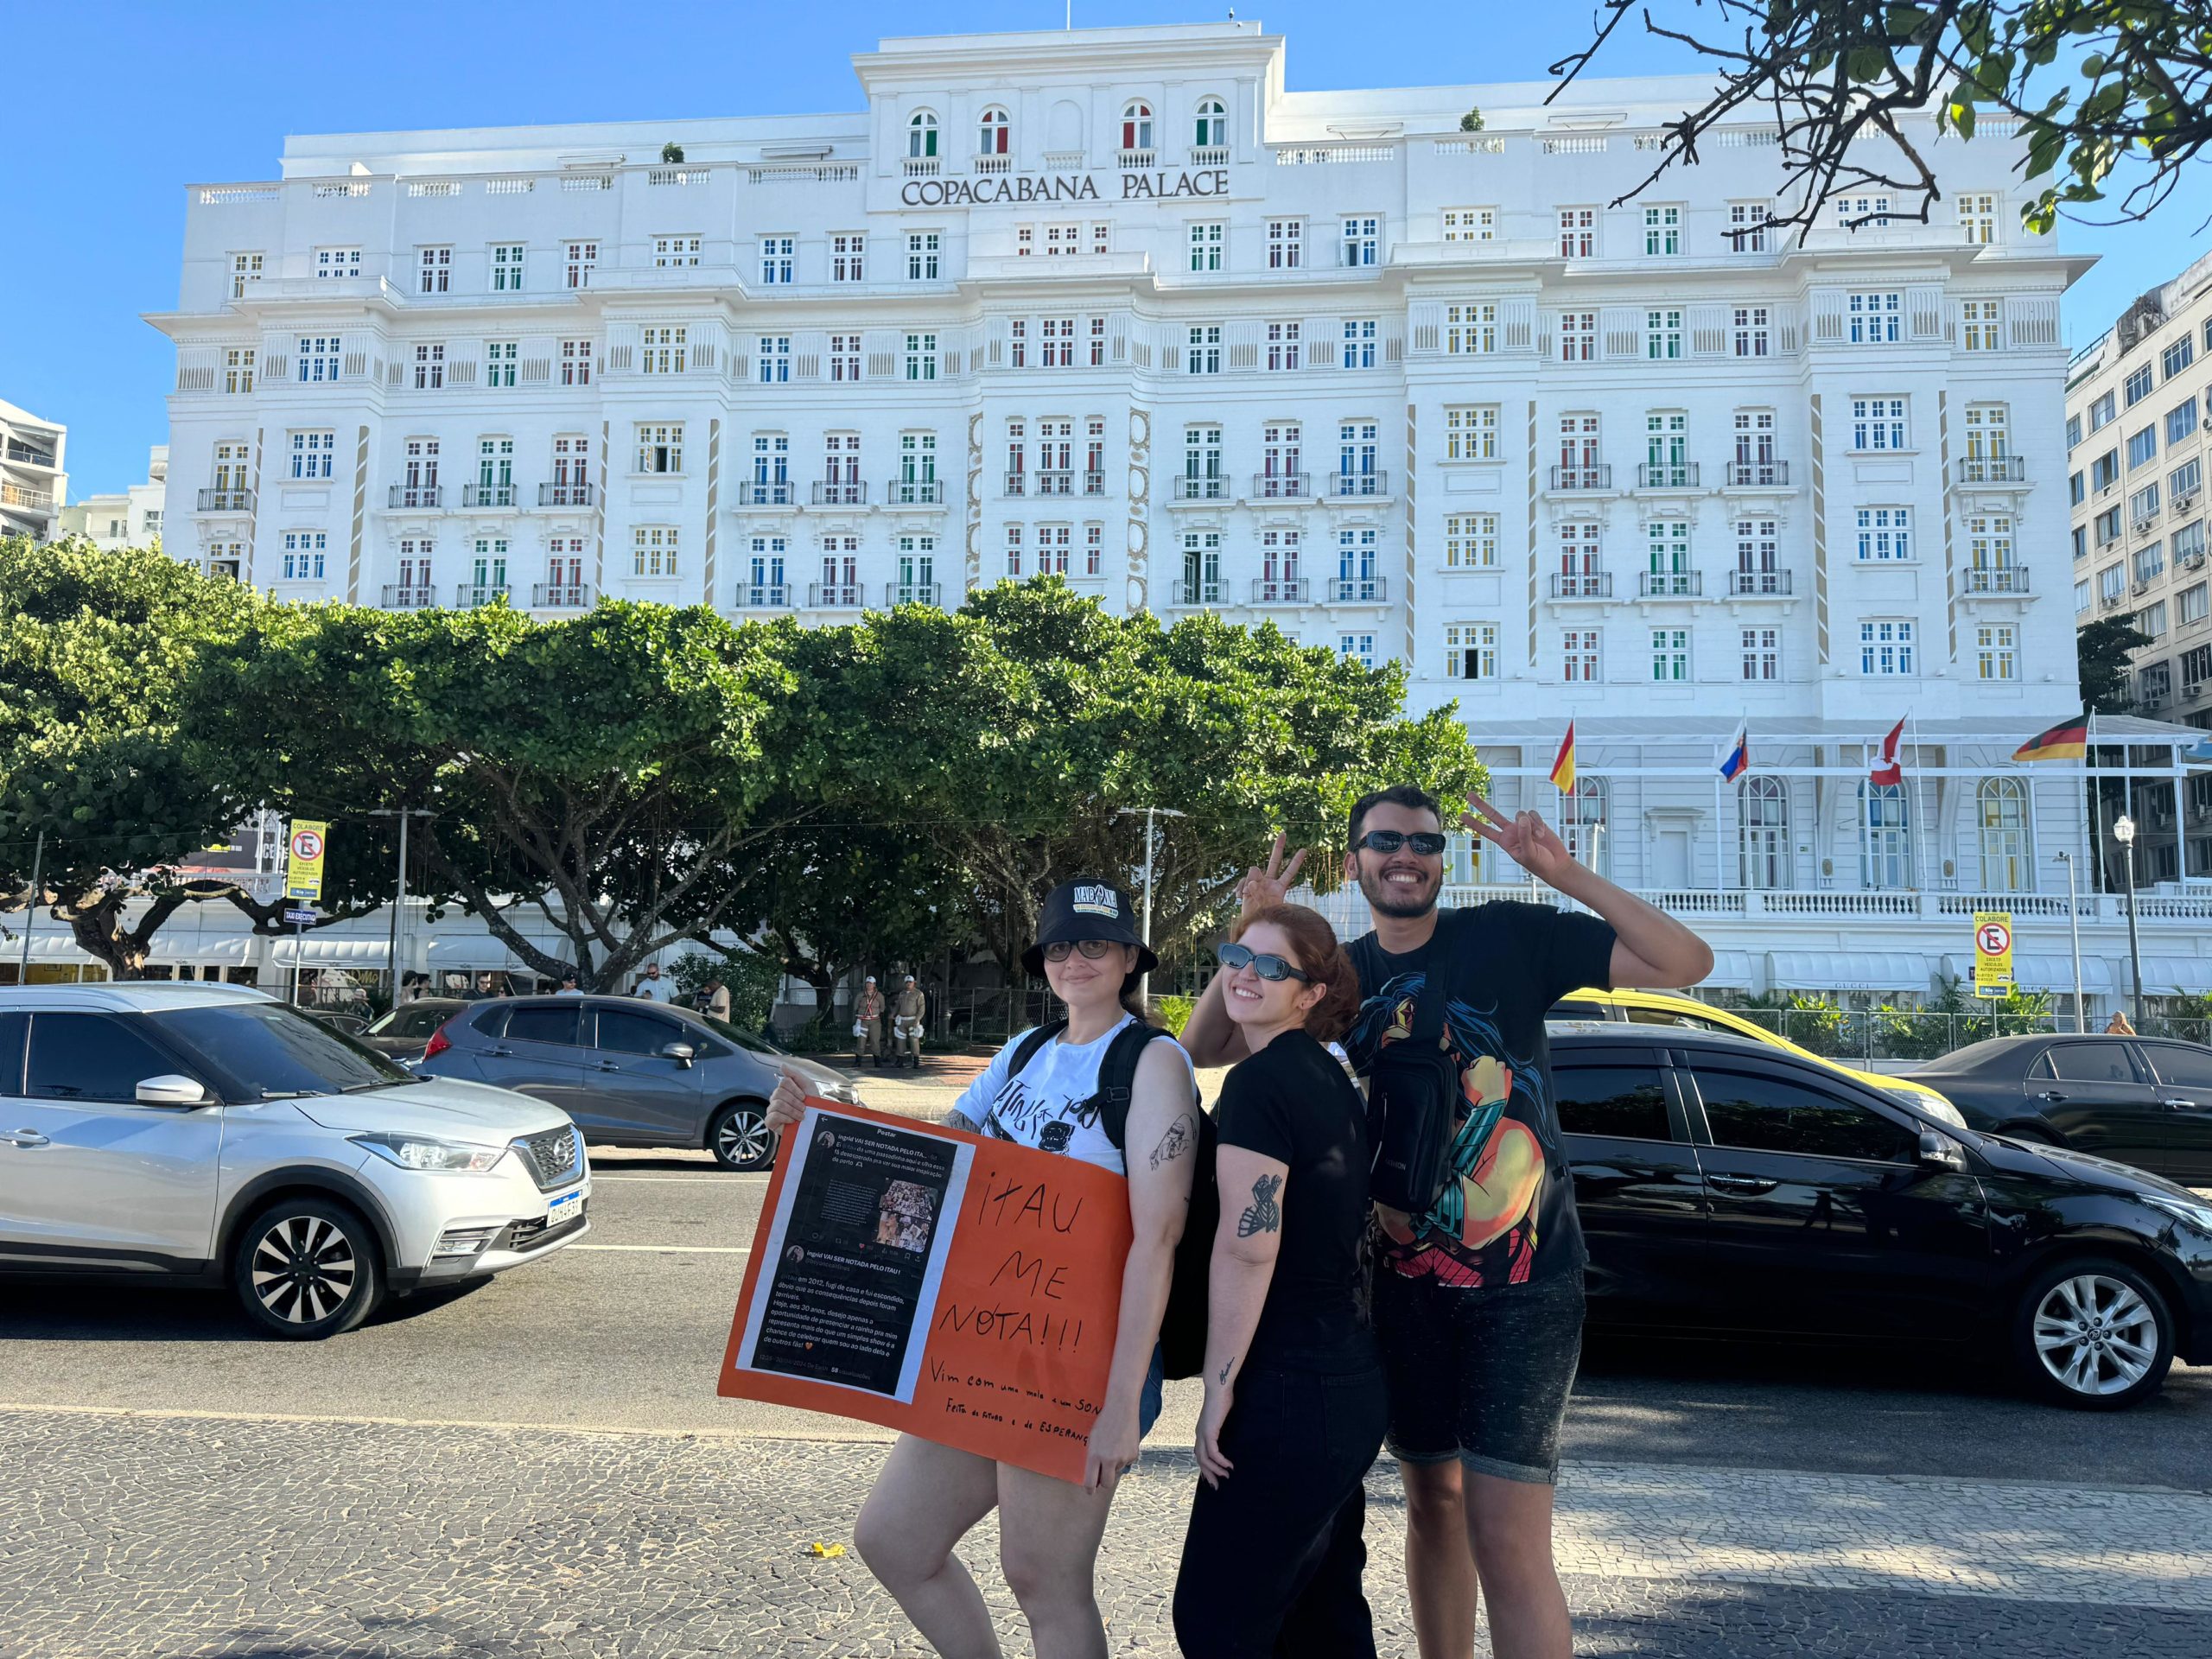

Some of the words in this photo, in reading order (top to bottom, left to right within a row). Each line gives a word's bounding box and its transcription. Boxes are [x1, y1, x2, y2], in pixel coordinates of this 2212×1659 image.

[901, 175, 1100, 207] COPACABANA
[1121, 169, 1229, 200] PALACE
[293, 823, 324, 831] COLABORE
[876, 1142, 899, 1152] NOTADA
[845, 1259, 869, 1268] NOTADA
[990, 1250, 1069, 1300] ME
[808, 1278, 825, 1287] 2012,
[859, 1298, 879, 1307] depois
[771, 1308, 810, 1322] oportunidade
[819, 1319, 850, 1329] presenciar
[827, 1310, 847, 1319] desejo
[847, 1315, 868, 1324] apenas
[766, 1326, 787, 1335] chance
[797, 1332, 821, 1341] celebrar
[768, 1318, 800, 1329] representa
[847, 1333, 869, 1343] simples
[931, 1357, 959, 1382] Vim
